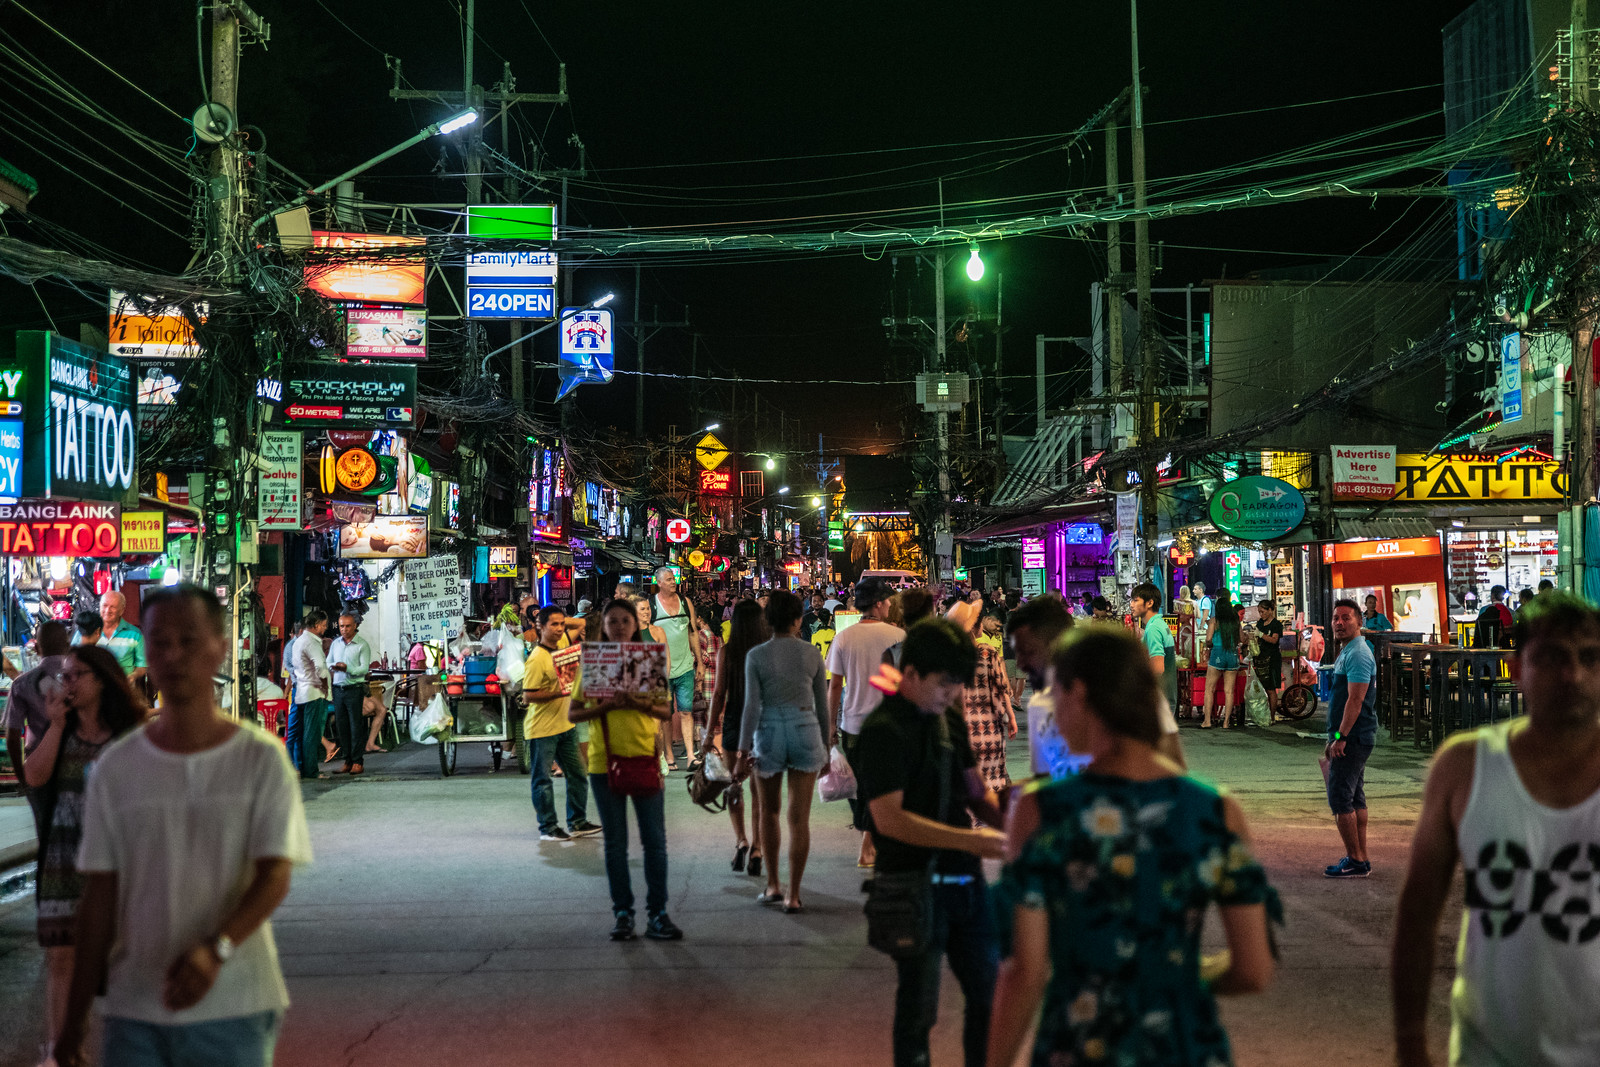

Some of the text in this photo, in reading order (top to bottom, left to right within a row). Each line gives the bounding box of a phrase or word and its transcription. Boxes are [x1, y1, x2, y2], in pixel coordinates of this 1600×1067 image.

[471, 252, 551, 267] FamilyMart
[349, 312, 398, 320] EURASIAN
[118, 318, 128, 340] i
[51, 358, 89, 390] BANGLAINK
[290, 380, 405, 392] STOCKHOLM
[295, 388, 400, 396] SYNDROME
[290, 407, 304, 415] 50
[50, 391, 134, 490] TATTOO
[1337, 450, 1390, 459] Advertise
[1350, 462, 1376, 471] Here
[263, 469, 297, 479] Salute
[1337, 485, 1392, 494] 081-6913577
[0, 506, 115, 519] BANGLAINK
[0, 522, 118, 552] TATTOO
[127, 538, 160, 550] TRAVEL
[1376, 542, 1399, 553] ATM
[490, 548, 516, 563] OILET
[406, 559, 457, 572] HAPPY HOURS
[406, 568, 458, 581] FOR BEER CHANG
[412, 582, 416, 590] 1
[445, 578, 454, 586] 79
[412, 591, 417, 599] 5
[444, 587, 458, 595] 350
[410, 599, 457, 612] HAPPY HOURS
[412, 609, 463, 621] FOR BEER SINGHA
